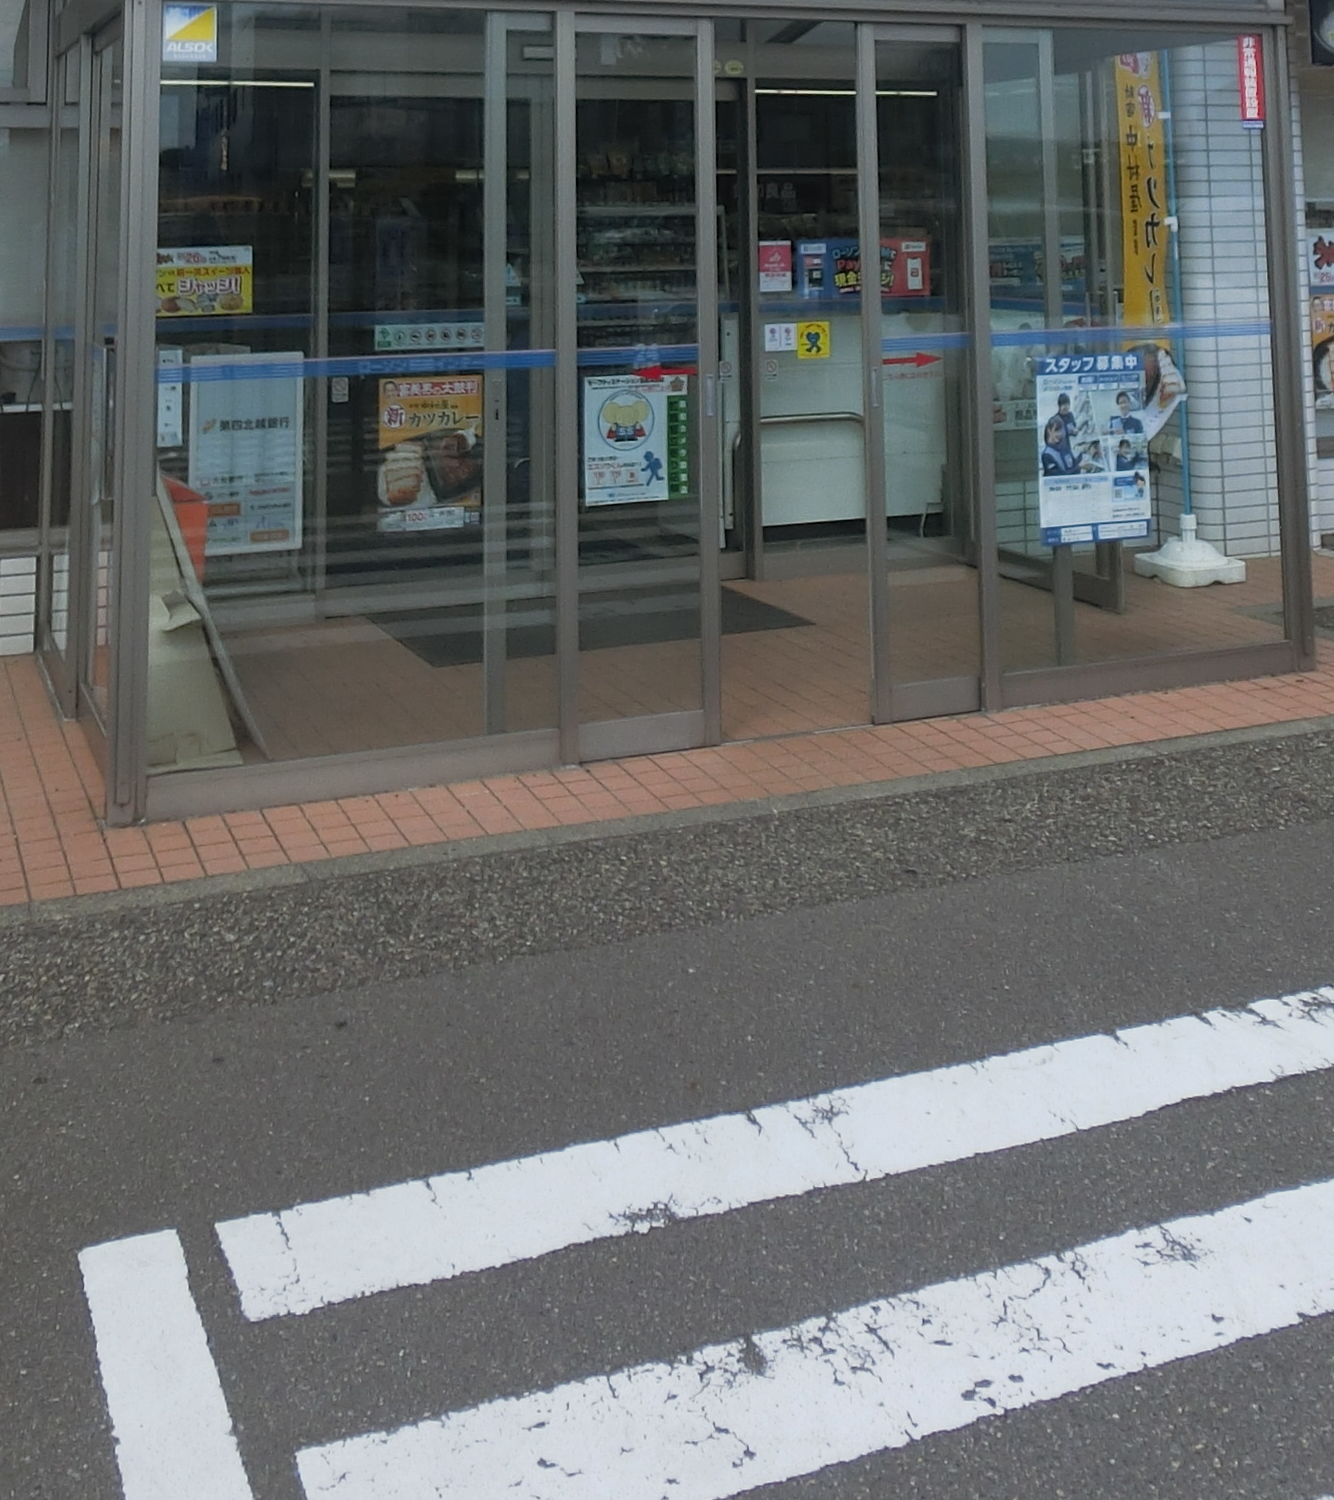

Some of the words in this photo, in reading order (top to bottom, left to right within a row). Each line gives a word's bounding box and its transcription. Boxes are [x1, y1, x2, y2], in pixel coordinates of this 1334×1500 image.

[166, 42, 214, 53] ALSOK
[1044, 354, 1138, 374] スタッフ募集中
[408, 411, 480, 428] カツカレー
